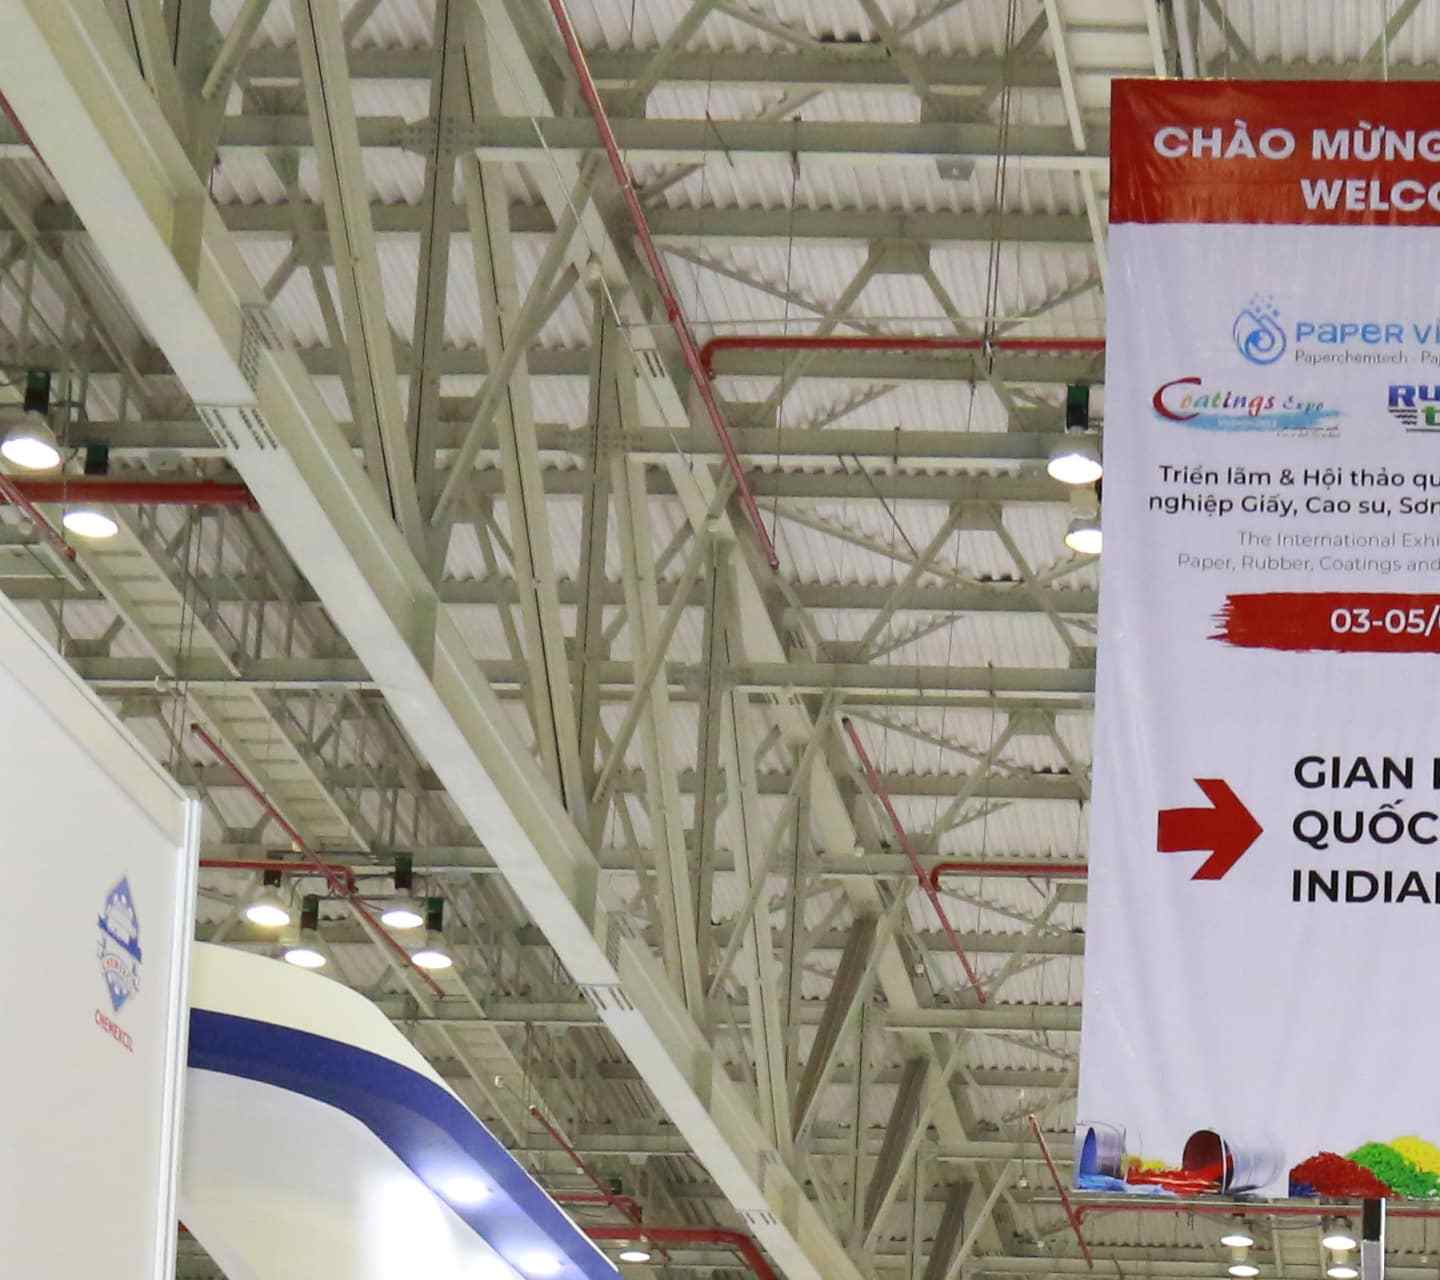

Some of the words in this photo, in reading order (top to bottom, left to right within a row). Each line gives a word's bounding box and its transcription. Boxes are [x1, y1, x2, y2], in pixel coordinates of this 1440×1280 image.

[1152, 120, 1296, 161] CHÀO
[1227, 466, 1271, 486] lãm
[1280, 470, 1294, 486] &
[1304, 468, 1342, 490] Hội
[1351, 466, 1404, 487] thảo
[1150, 493, 1233, 517] nghiệp
[1306, 497, 1351, 513] Cao
[1359, 498, 1391, 516] su,
[1237, 531, 1271, 546] The
[1278, 532, 1396, 547] International
[1320, 556, 1401, 574] Coatings
[1408, 557, 1440, 571] and
[1294, 756, 1414, 790] GIAN
[1292, 800, 1439, 851] QUỐC
